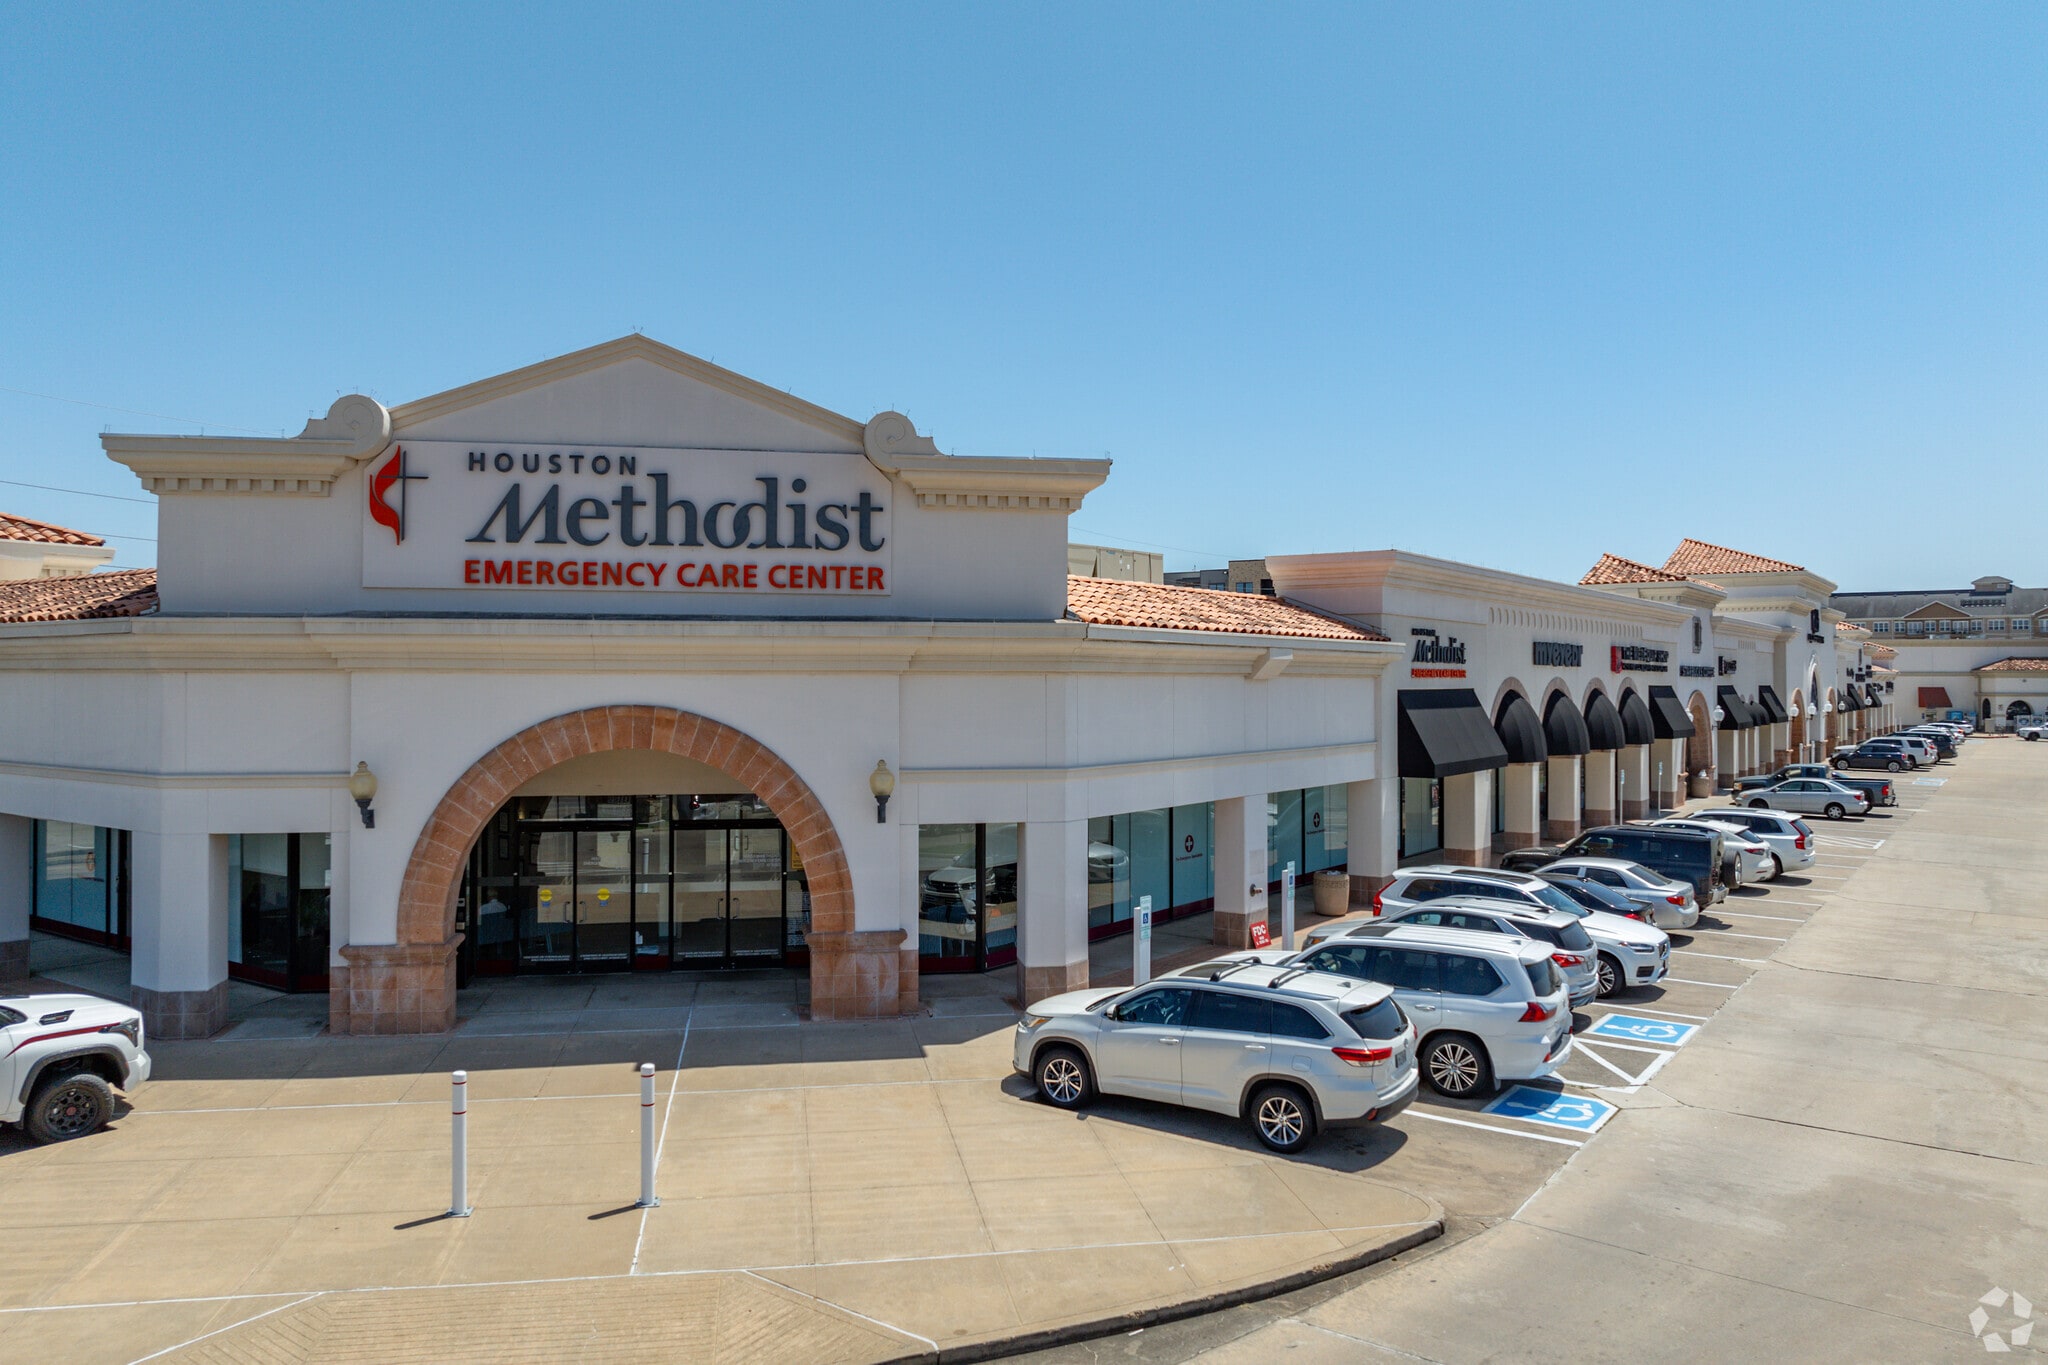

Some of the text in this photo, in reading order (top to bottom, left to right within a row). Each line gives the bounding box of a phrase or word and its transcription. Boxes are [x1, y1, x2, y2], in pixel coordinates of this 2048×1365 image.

[467, 451, 638, 477] HOUSTON
[464, 472, 886, 553] Methodist
[464, 558, 884, 590] EMERGENCY CARE CENTER
[1411, 635, 1467, 665] Methodist
[1252, 924, 1267, 937] FDC
